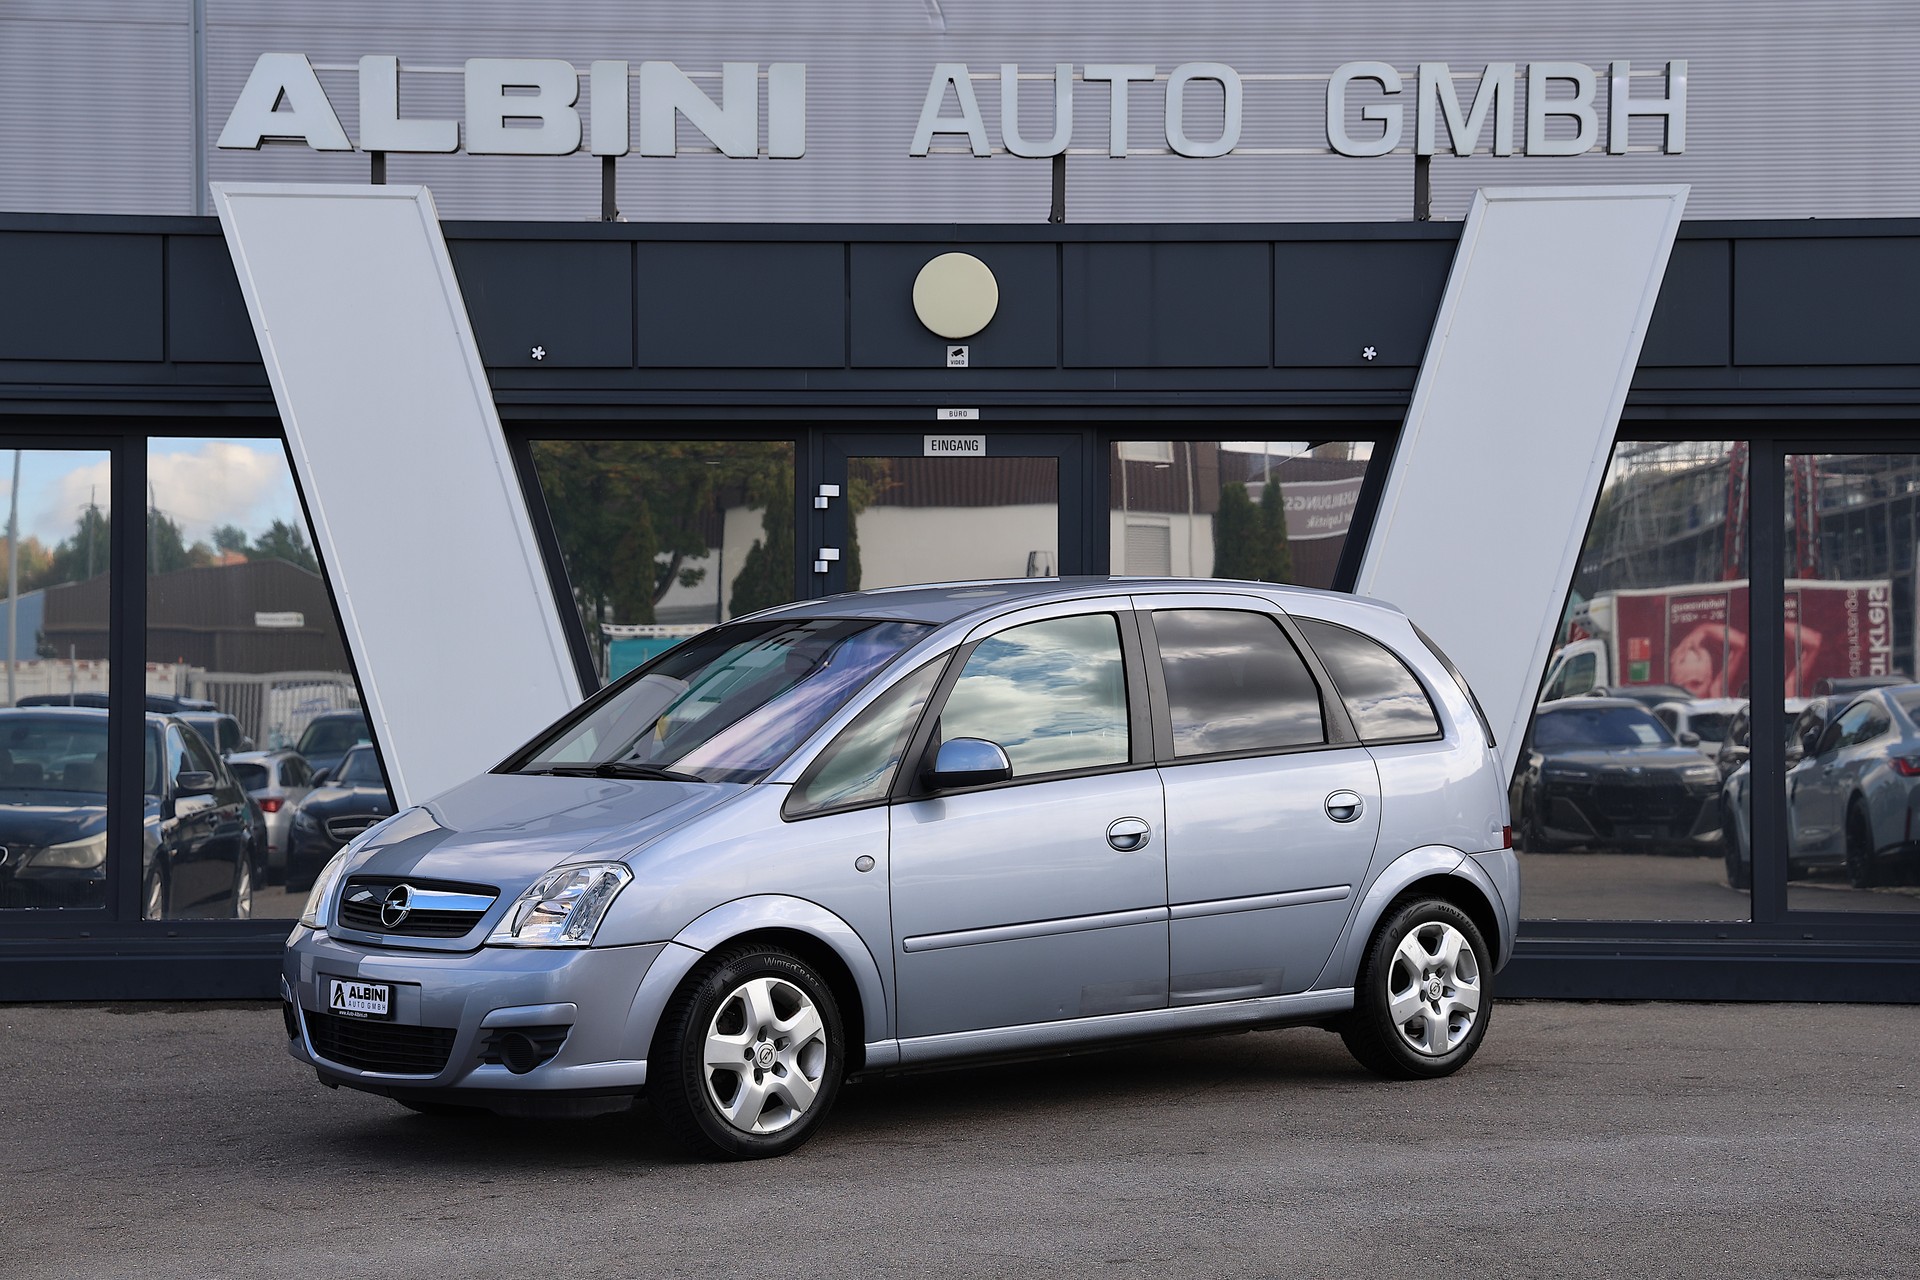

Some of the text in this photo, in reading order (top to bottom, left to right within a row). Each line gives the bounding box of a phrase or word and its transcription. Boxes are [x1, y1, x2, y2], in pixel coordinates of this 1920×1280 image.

[216, 52, 1688, 159] ALBINI AUTO GMBH
[948, 410, 968, 418] BÜRO
[931, 440, 979, 451] EINGANG
[349, 985, 386, 1002] ALBINI
[348, 1001, 386, 1011] AUTO GMBH
